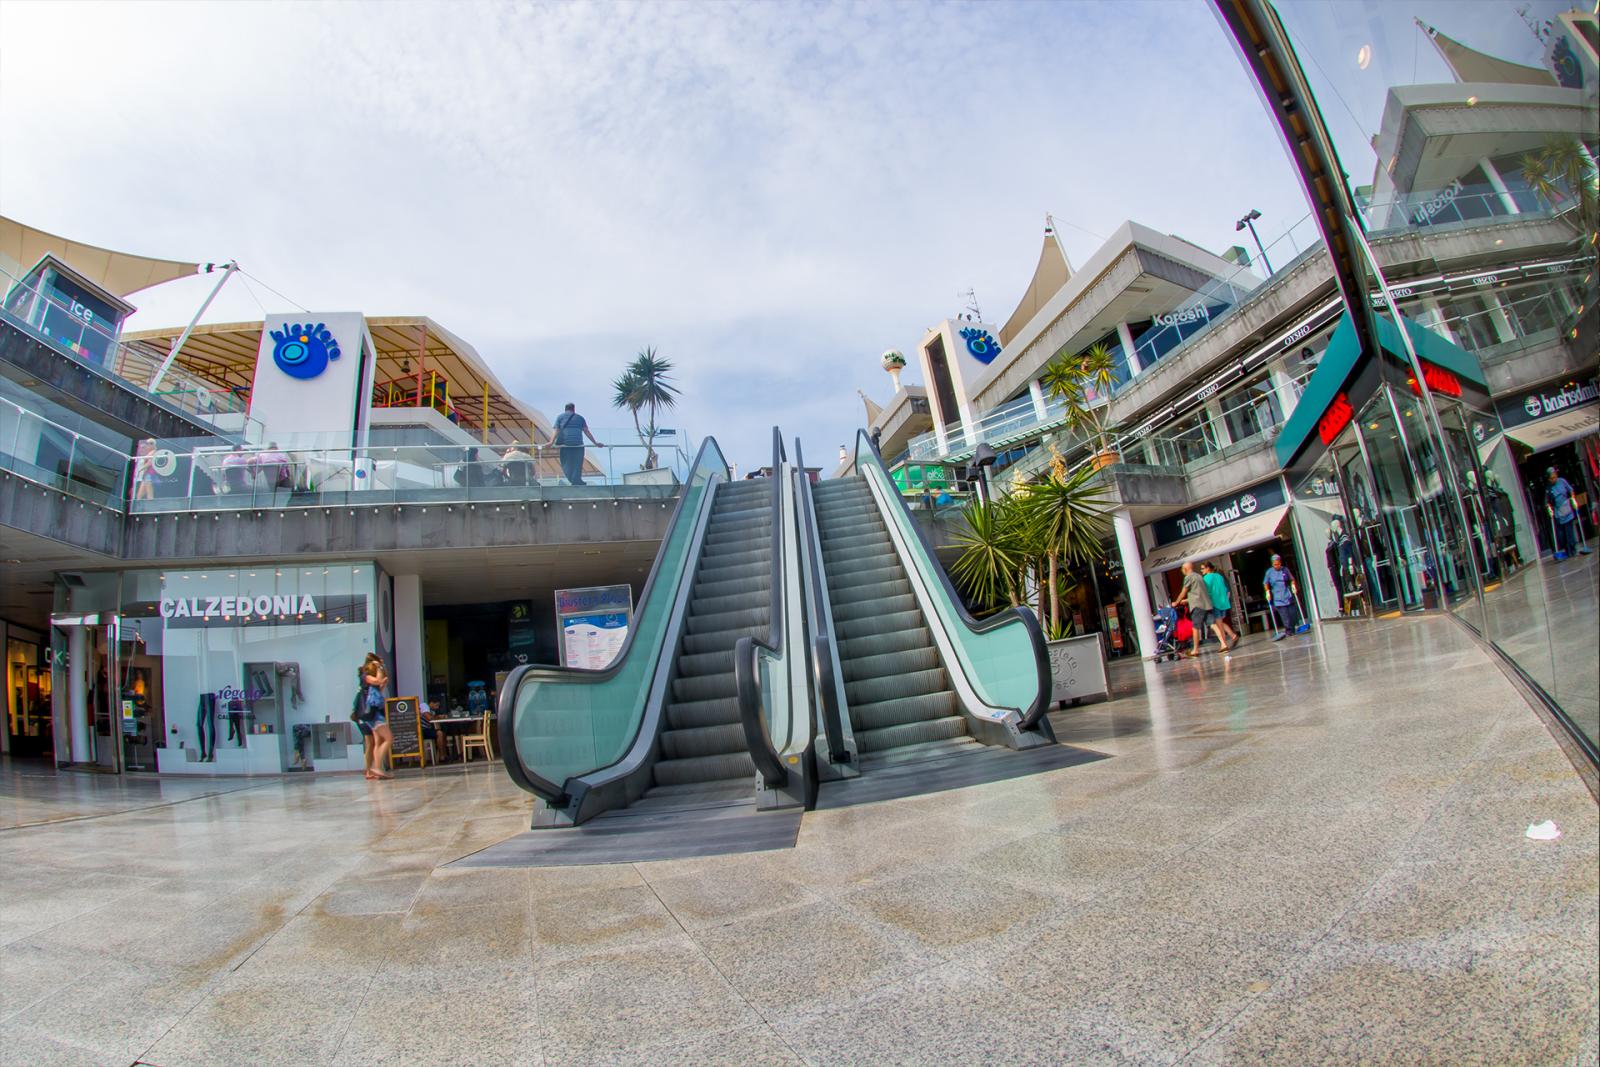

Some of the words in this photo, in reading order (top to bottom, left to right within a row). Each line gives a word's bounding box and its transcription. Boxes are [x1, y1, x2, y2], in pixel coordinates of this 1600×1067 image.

[70, 300, 93, 321] ice
[1284, 325, 1311, 346] OYSHO
[1197, 383, 1219, 400] OYSHO
[1177, 500, 1240, 536] Timberland
[159, 593, 317, 618] CALZEDONIA
